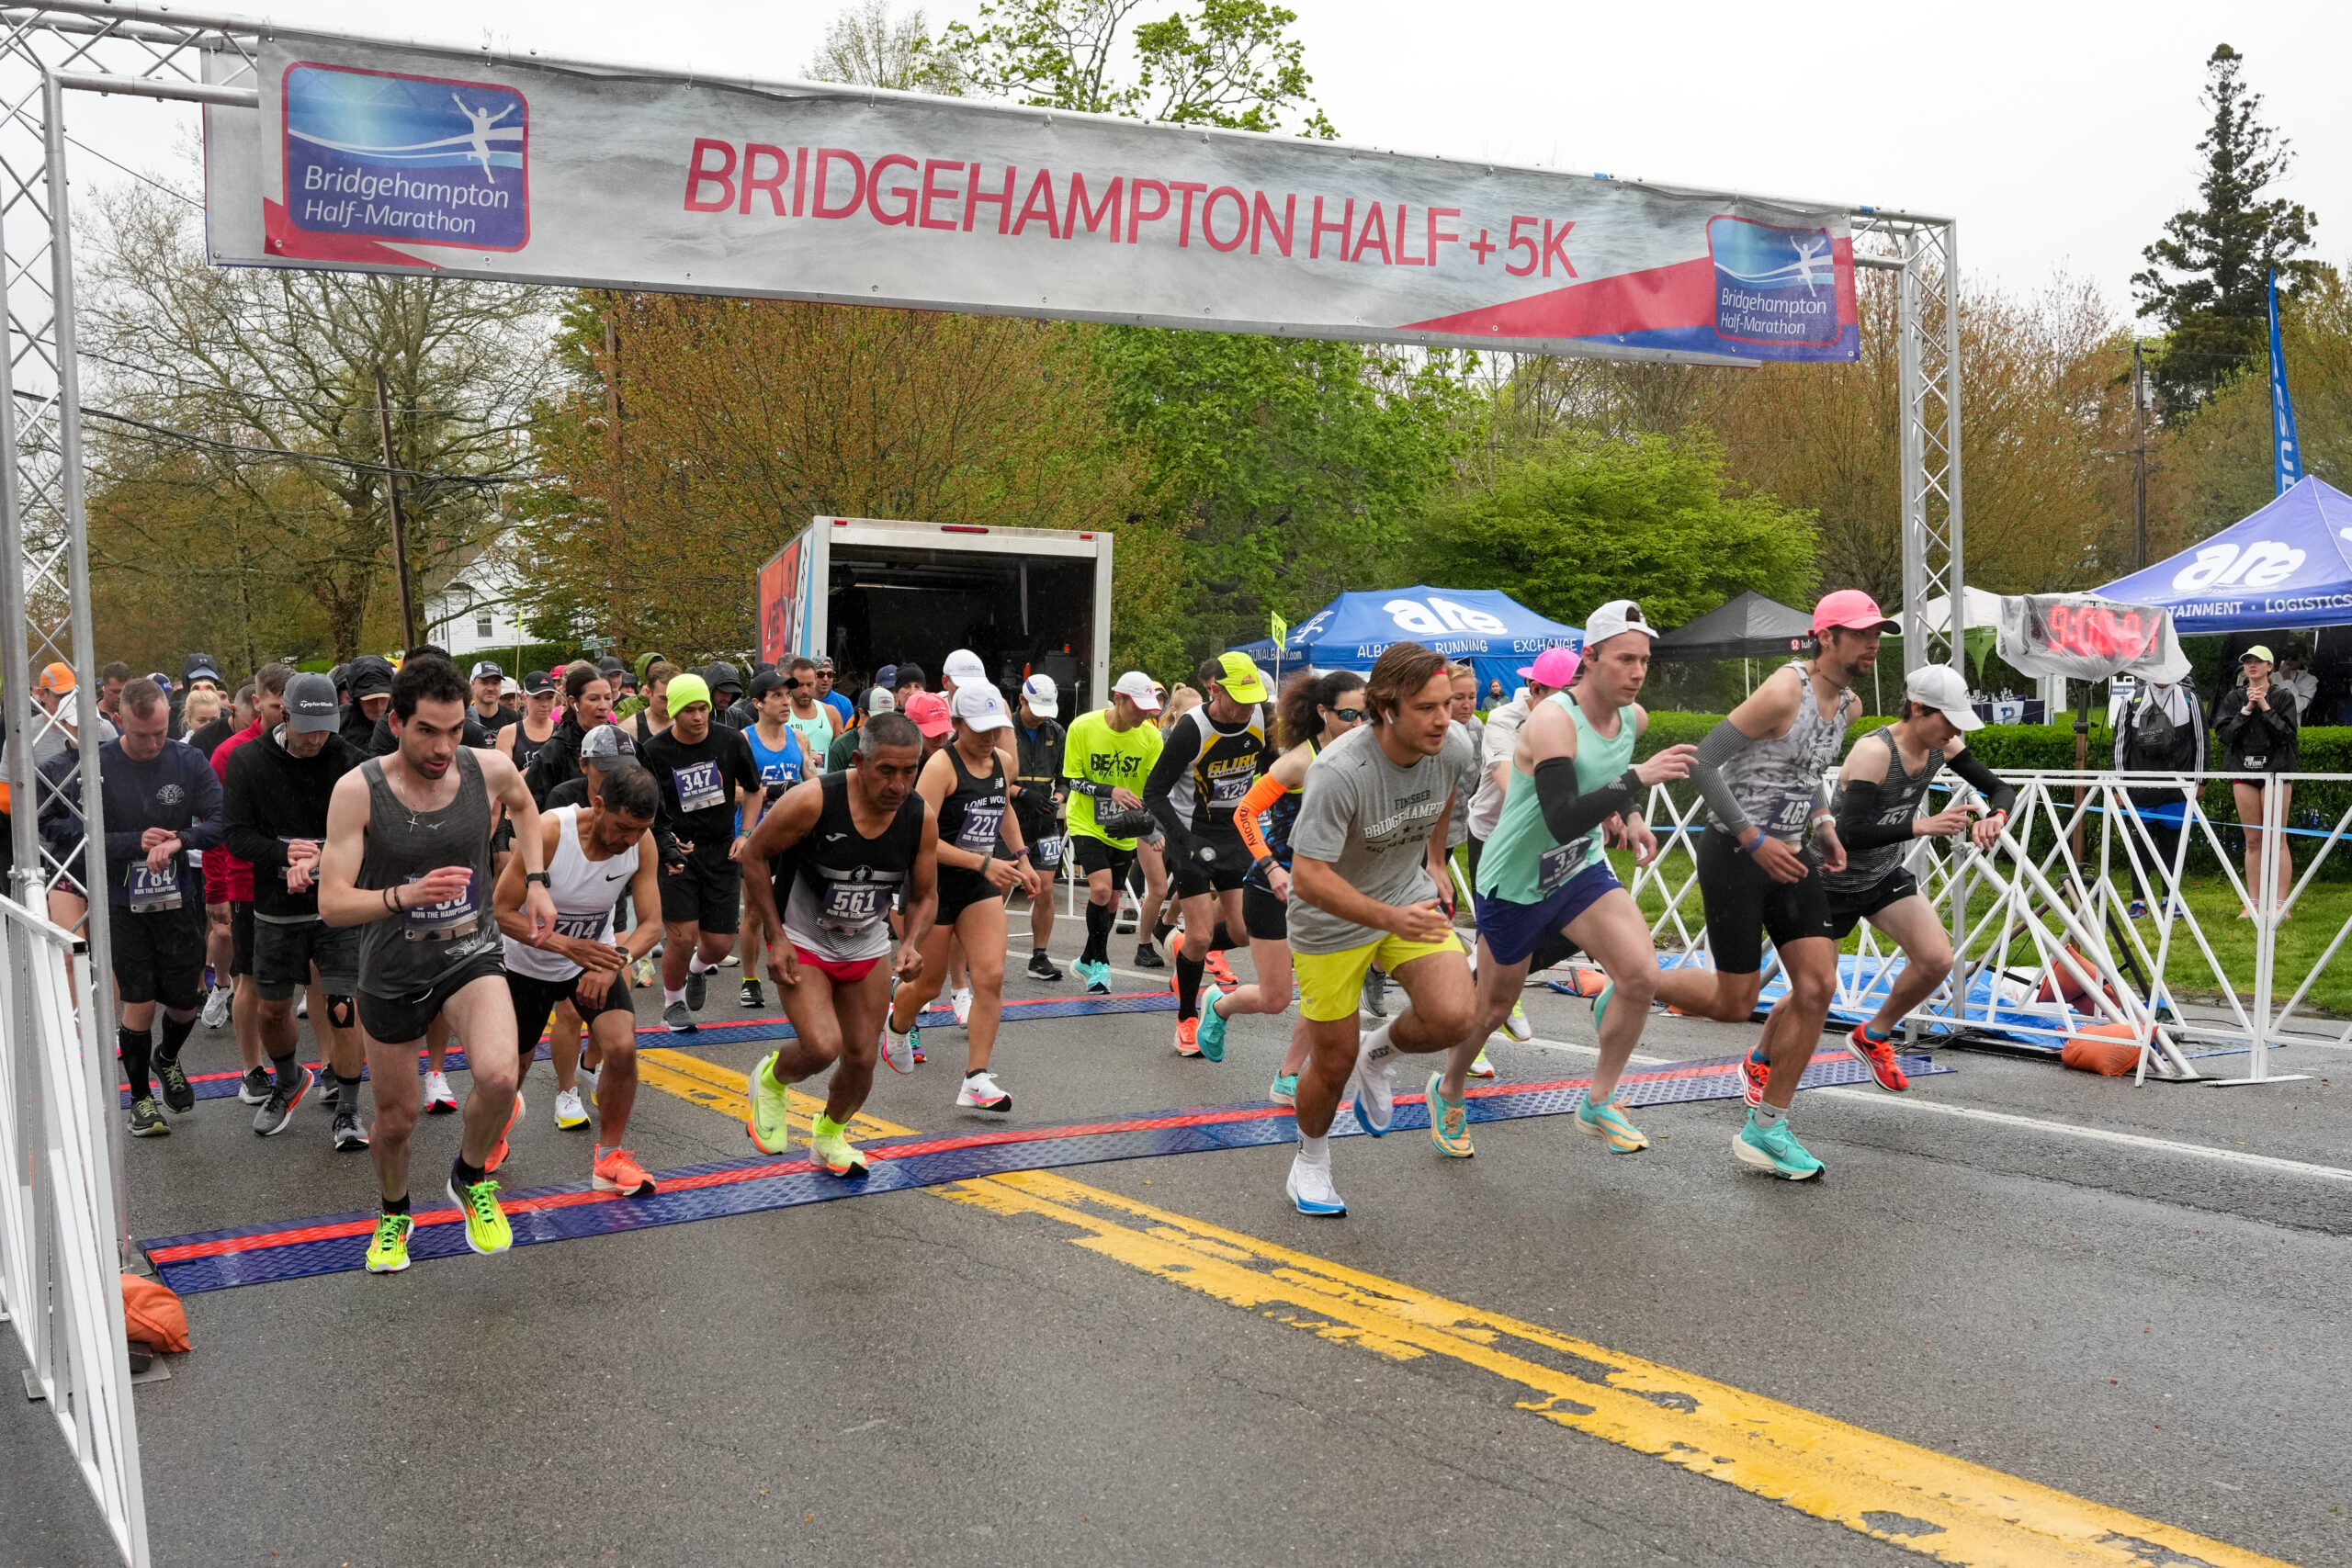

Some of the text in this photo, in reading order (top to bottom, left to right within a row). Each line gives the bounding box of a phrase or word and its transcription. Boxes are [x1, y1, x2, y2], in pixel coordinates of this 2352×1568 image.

[304, 165, 509, 209] Bridgehampton
[684, 137, 1296, 257] BRIDGEHAMPTON
[1310, 196, 1461, 266] HALF
[304, 198, 476, 234] Half-Marathon
[1722, 288, 1826, 315] Bridgehampton
[1721, 315, 1806, 335] Half-Marathon
[1357, 638, 1577, 659] ALBA RUNNING EXCHANGE
[300, 700, 334, 708] TaylorMade
[1091, 750, 1142, 773] BEAST
[682, 769, 711, 792] 347
[1070, 779, 1097, 795] BEAST
[1222, 780, 1249, 799] 325
[964, 797, 988, 811] LONE
[1780, 800, 1811, 824] 469
[967, 816, 999, 836] 221
[136, 867, 172, 887] 784
[412, 910, 425, 919] RUN
[440, 903, 471, 918] HAMPTONS
[833, 890, 876, 912] 561
[555, 920, 598, 939] 704
